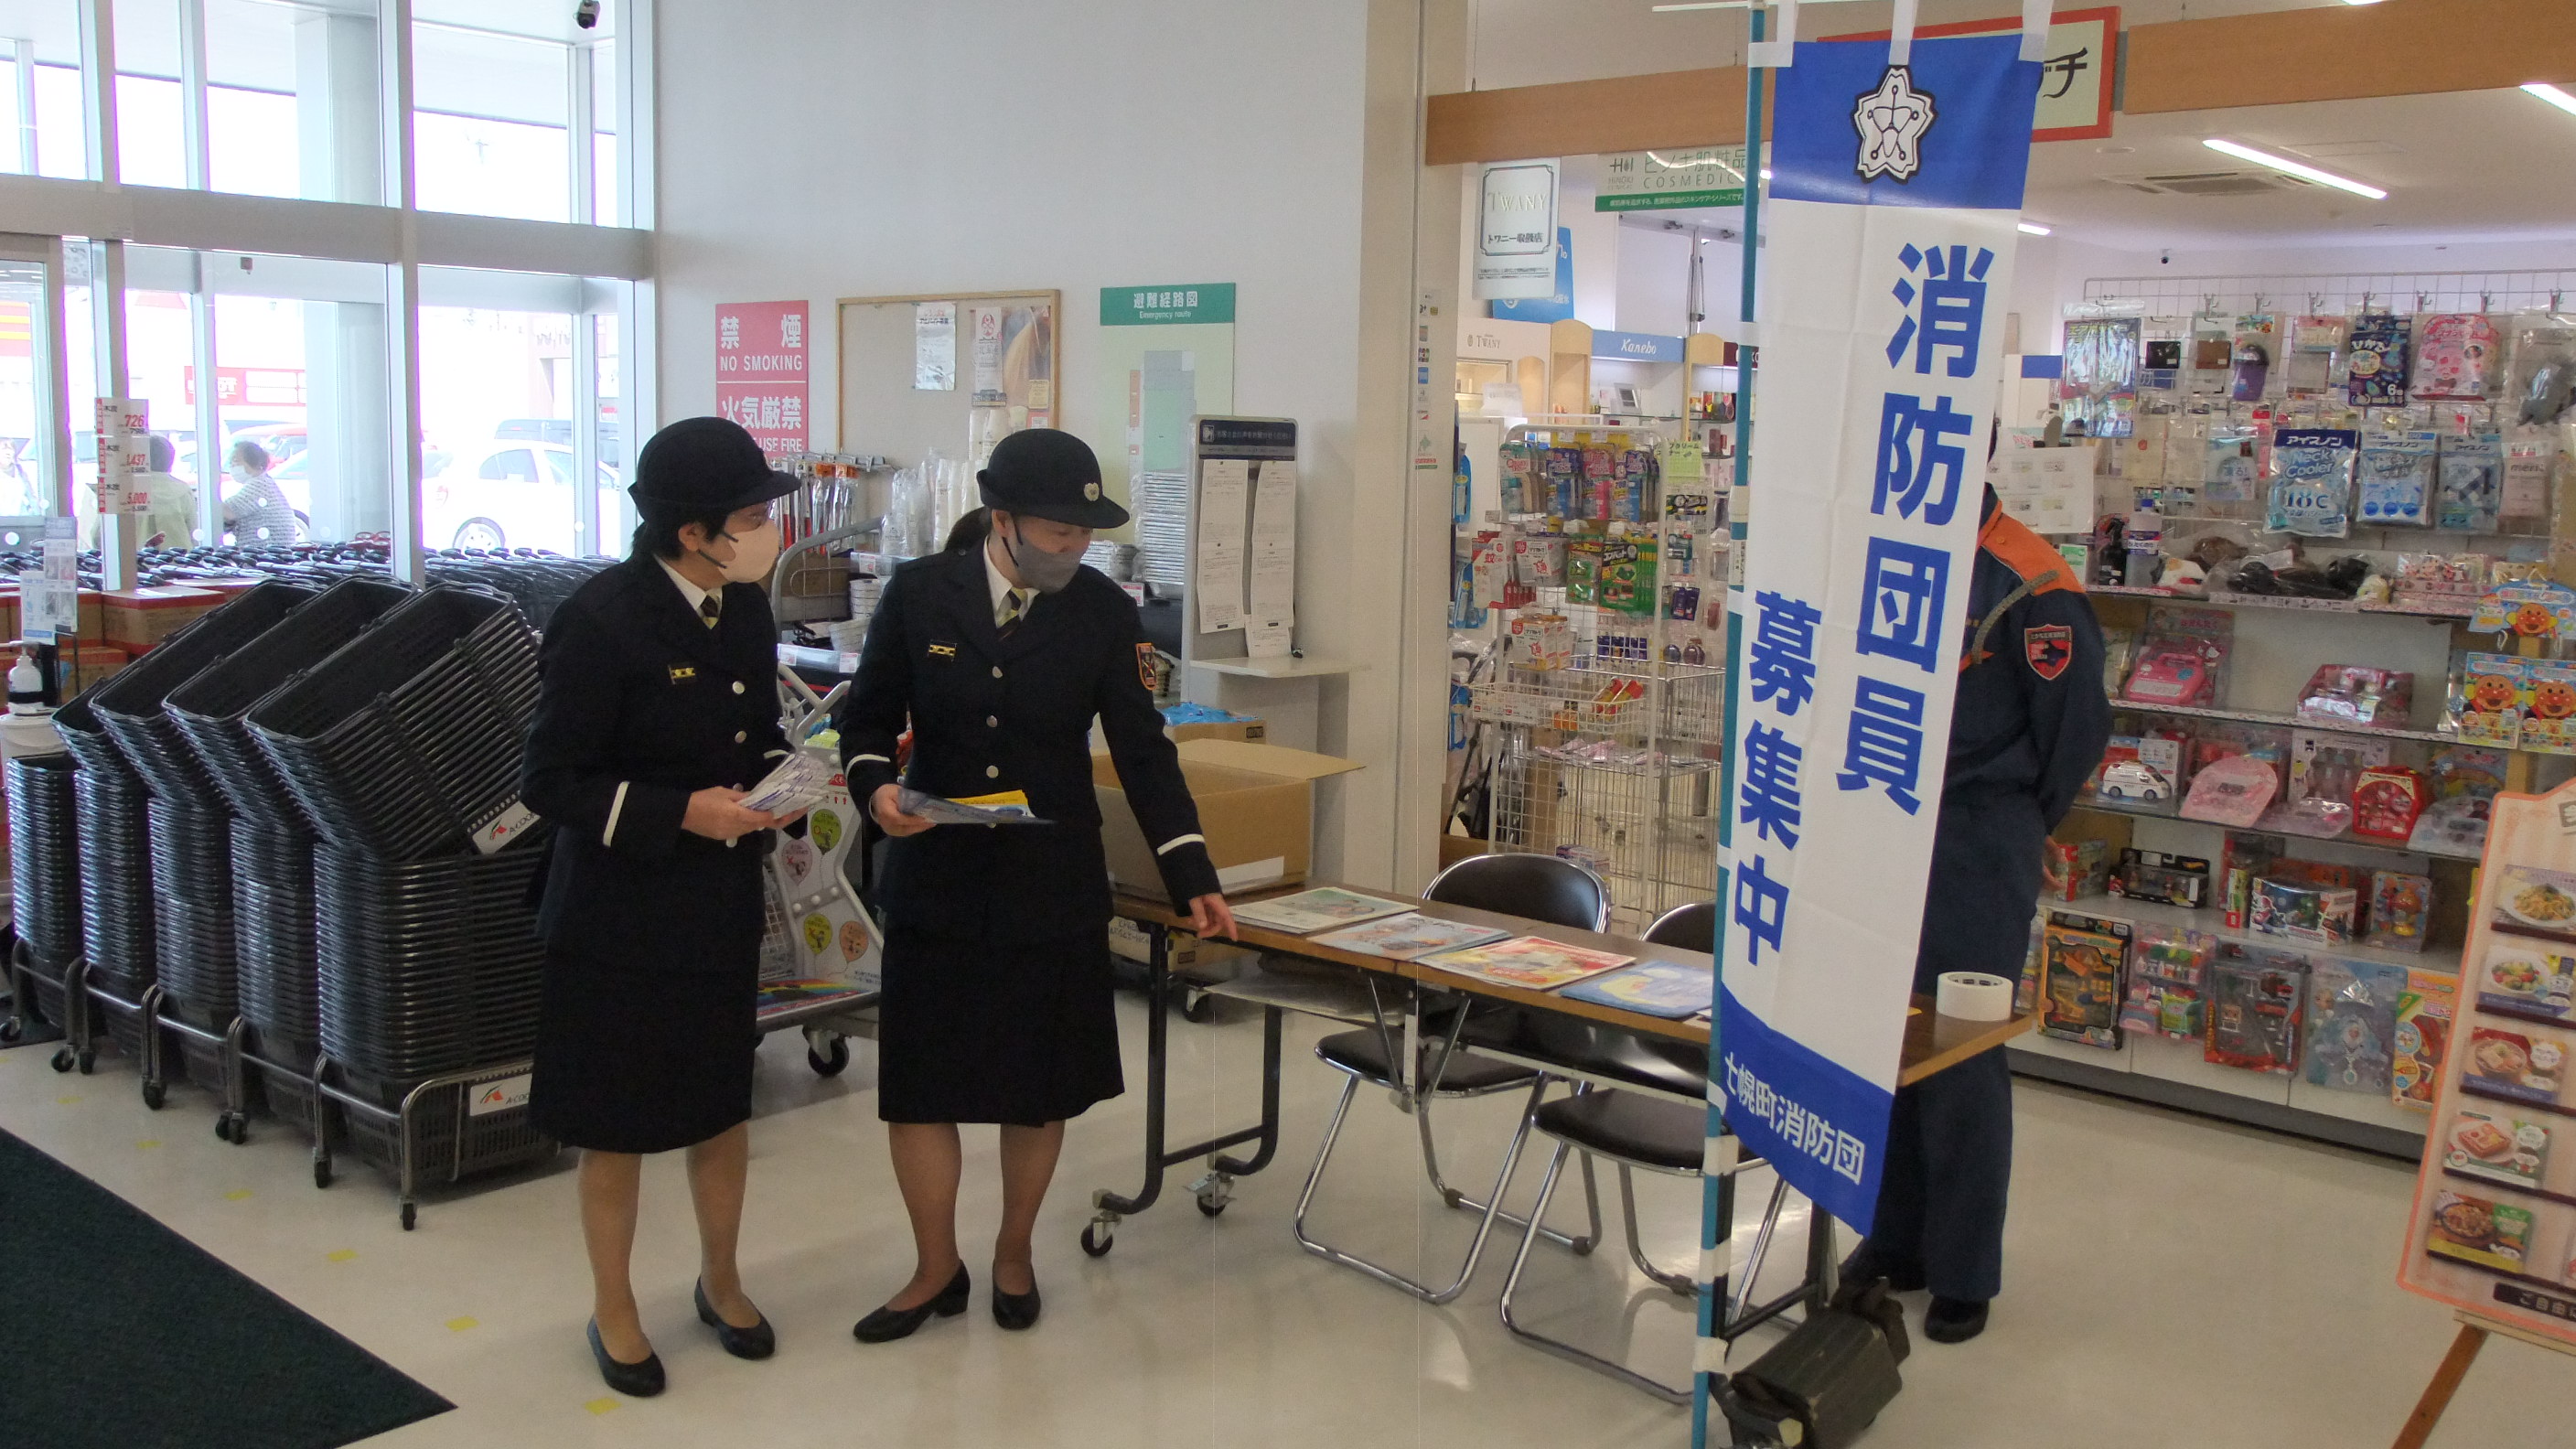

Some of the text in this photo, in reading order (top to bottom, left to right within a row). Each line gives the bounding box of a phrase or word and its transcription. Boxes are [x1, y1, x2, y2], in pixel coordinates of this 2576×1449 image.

[2038, 47, 2088, 99] チ
[1643, 173, 1746, 189] COSMEDIC
[1487, 192, 1548, 212] TWANY
[1487, 232, 1543, 244] トワニー取扱店
[1133, 291, 1198, 309] 避難経路図
[1139, 310, 1192, 320] Emergency route
[1476, 335, 1501, 349] TWANY
[1621, 338, 1657, 355] Kanebo
[720, 354, 802, 371] NO SMOKING
[124, 414, 145, 427] 726
[722, 395, 801, 430] 火気厳禁
[759, 437, 802, 452] USE FIRE
[2287, 435, 2342, 446] アイスノン
[2287, 463, 2334, 478] Cooler
[1836, 242, 1995, 817] 消防団員
[1734, 590, 1822, 966] 募集中
[1724, 1051, 1865, 1186] 士幌町消防団
